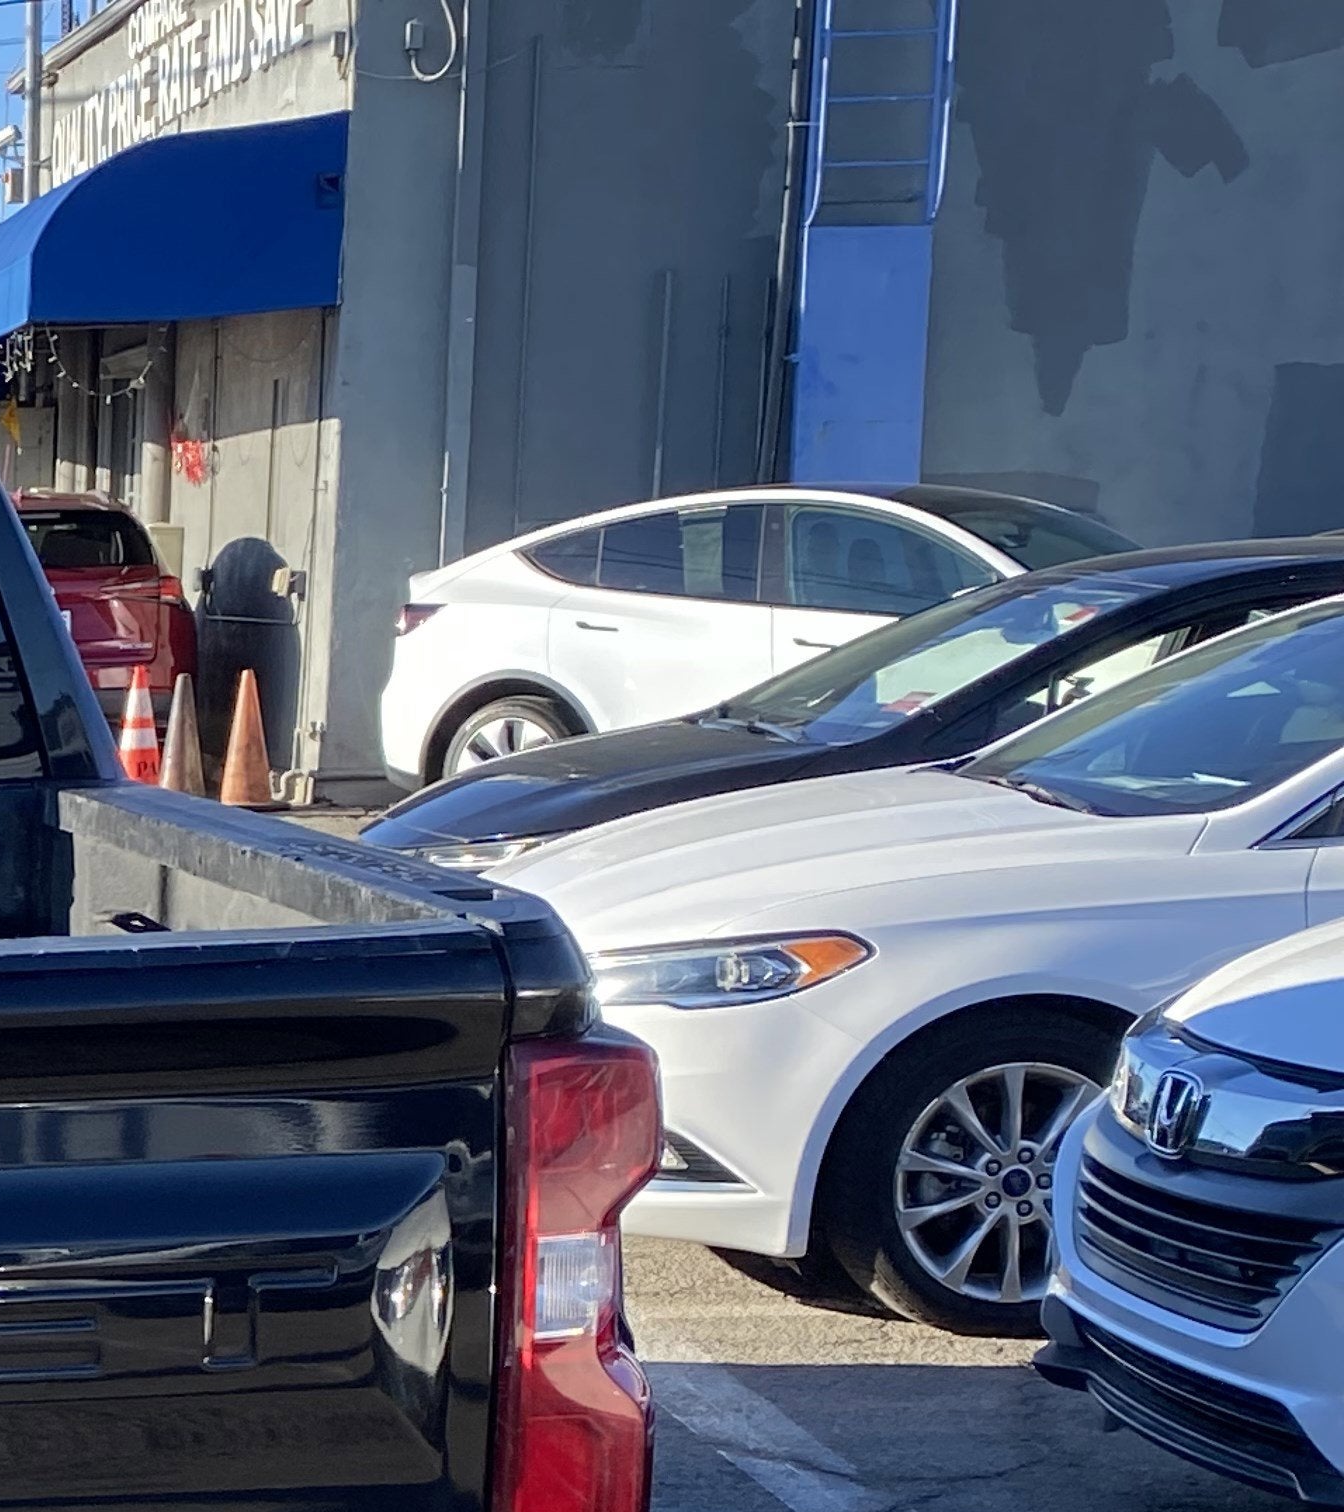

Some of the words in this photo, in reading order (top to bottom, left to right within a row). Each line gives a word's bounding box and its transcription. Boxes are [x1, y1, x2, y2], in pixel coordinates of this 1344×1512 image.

[157, 19, 202, 126] RATE
[204, 0, 246, 99] AND
[249, 0, 304, 73] SAVE
